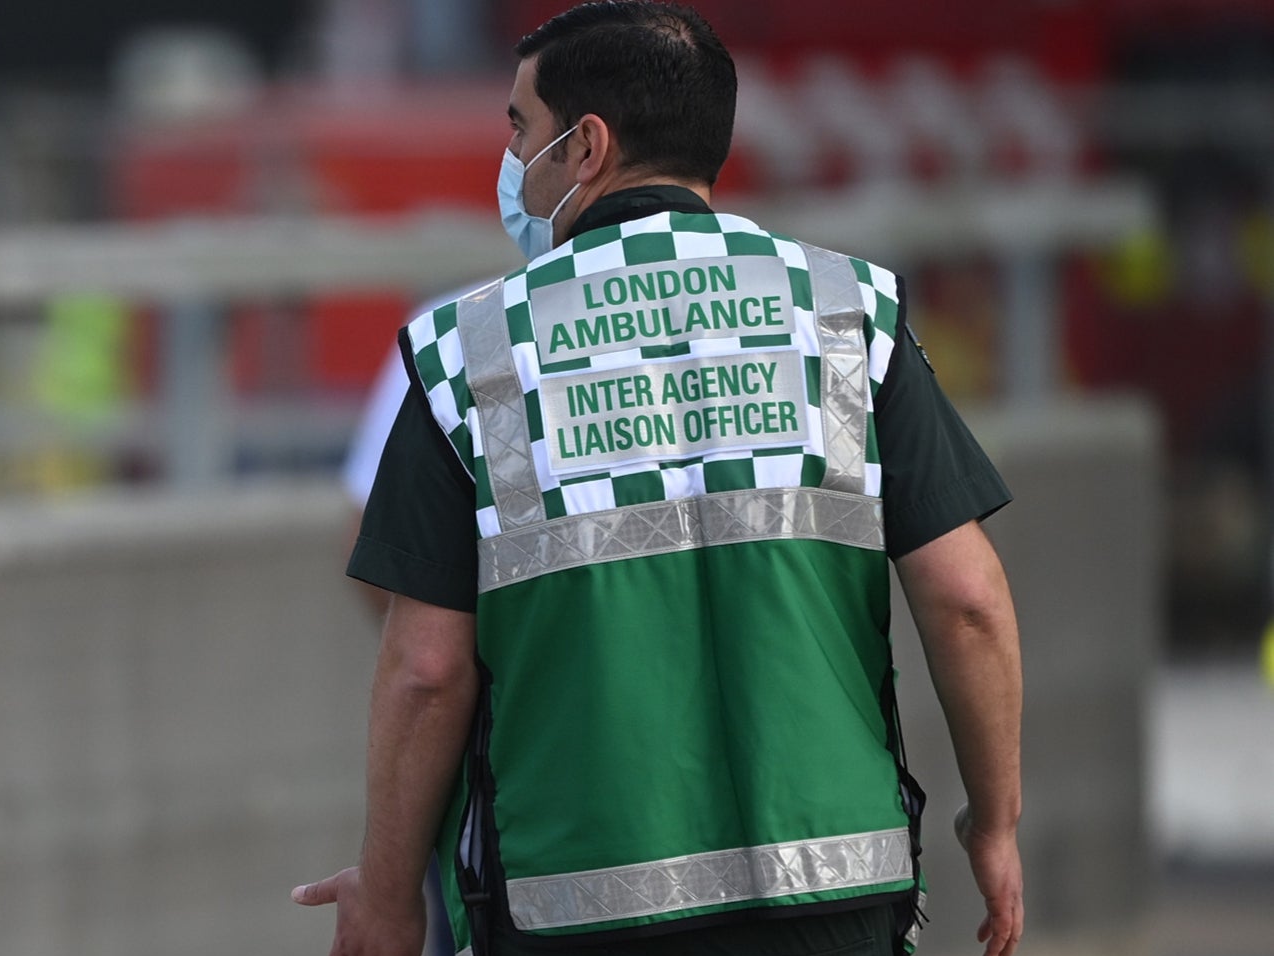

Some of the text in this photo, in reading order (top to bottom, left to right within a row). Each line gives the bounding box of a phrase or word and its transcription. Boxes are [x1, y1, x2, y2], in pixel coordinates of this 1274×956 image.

[583, 264, 737, 310] LONDON
[548, 295, 784, 354] AMBULANCE
[566, 362, 777, 418] INTER AGENCY
[556, 400, 799, 460] LIAISON OFFICER
